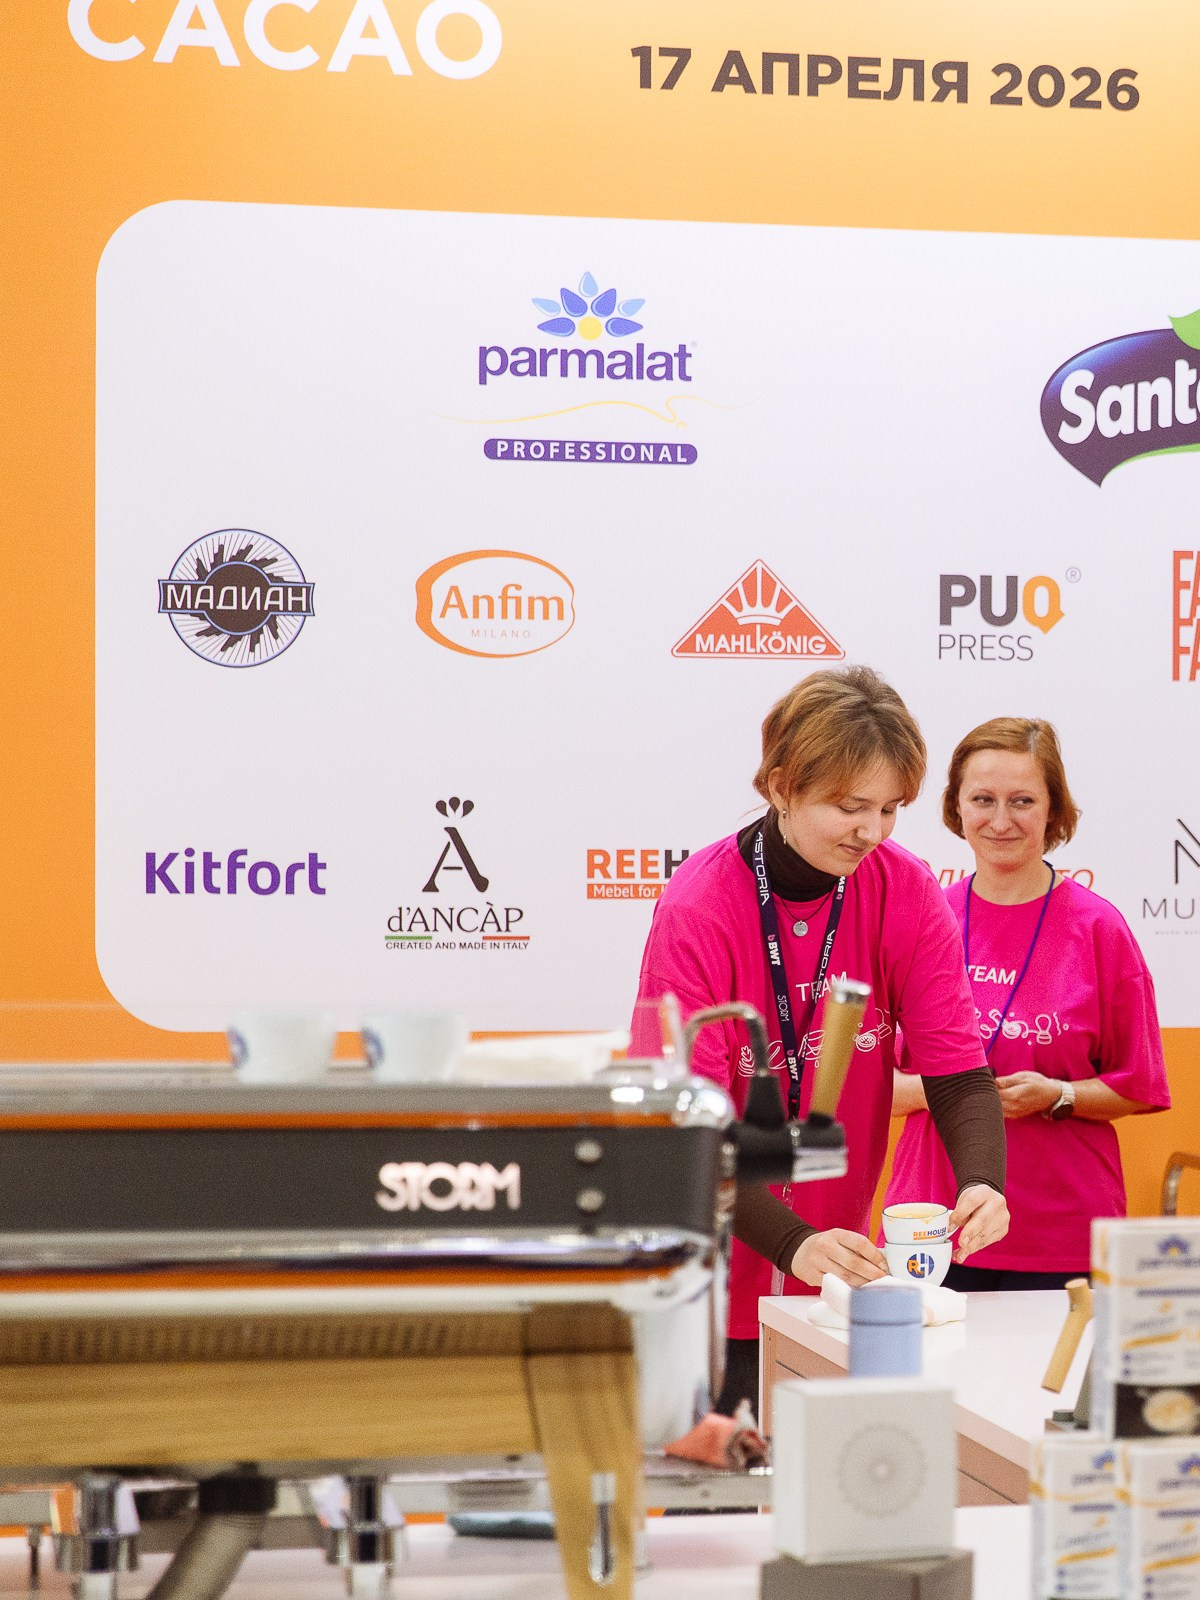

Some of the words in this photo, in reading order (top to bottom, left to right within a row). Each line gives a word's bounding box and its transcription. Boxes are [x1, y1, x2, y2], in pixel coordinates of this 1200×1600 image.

[67, 0, 503, 80] CACAO
[630, 45, 692, 90] 17
[711, 49, 969, 104] АПРЕЛЯ
[990, 63, 1141, 111] 2026
[478, 343, 692, 385] parmalat
[496, 440, 688, 463] PROFESSIONAL
[167, 584, 307, 612] МАДИАН
[439, 583, 565, 621] Anfim
[939, 574, 1065, 635] PUQ
[471, 629, 531, 639] MILANO
[938, 633, 1034, 661] PRESS
[145, 847, 327, 896] Kitfort
[587, 849, 690, 879] REEH
[754, 831, 770, 906] ASTORIA
[593, 884, 634, 898] Mebel
[638, 885, 657, 898] for
[385, 941, 432, 950] CREATED
[435, 942, 456, 950] AND
[459, 942, 487, 950] MADE
[490, 942, 500, 950] IN
[503, 942, 529, 950] ITALY
[768, 942, 781, 966] BWT
[816, 929, 836, 992] STORIA
[967, 965, 1017, 985] TEAM
[787, 1056, 799, 1081] BWT
[375, 1161, 521, 1212] STORM
